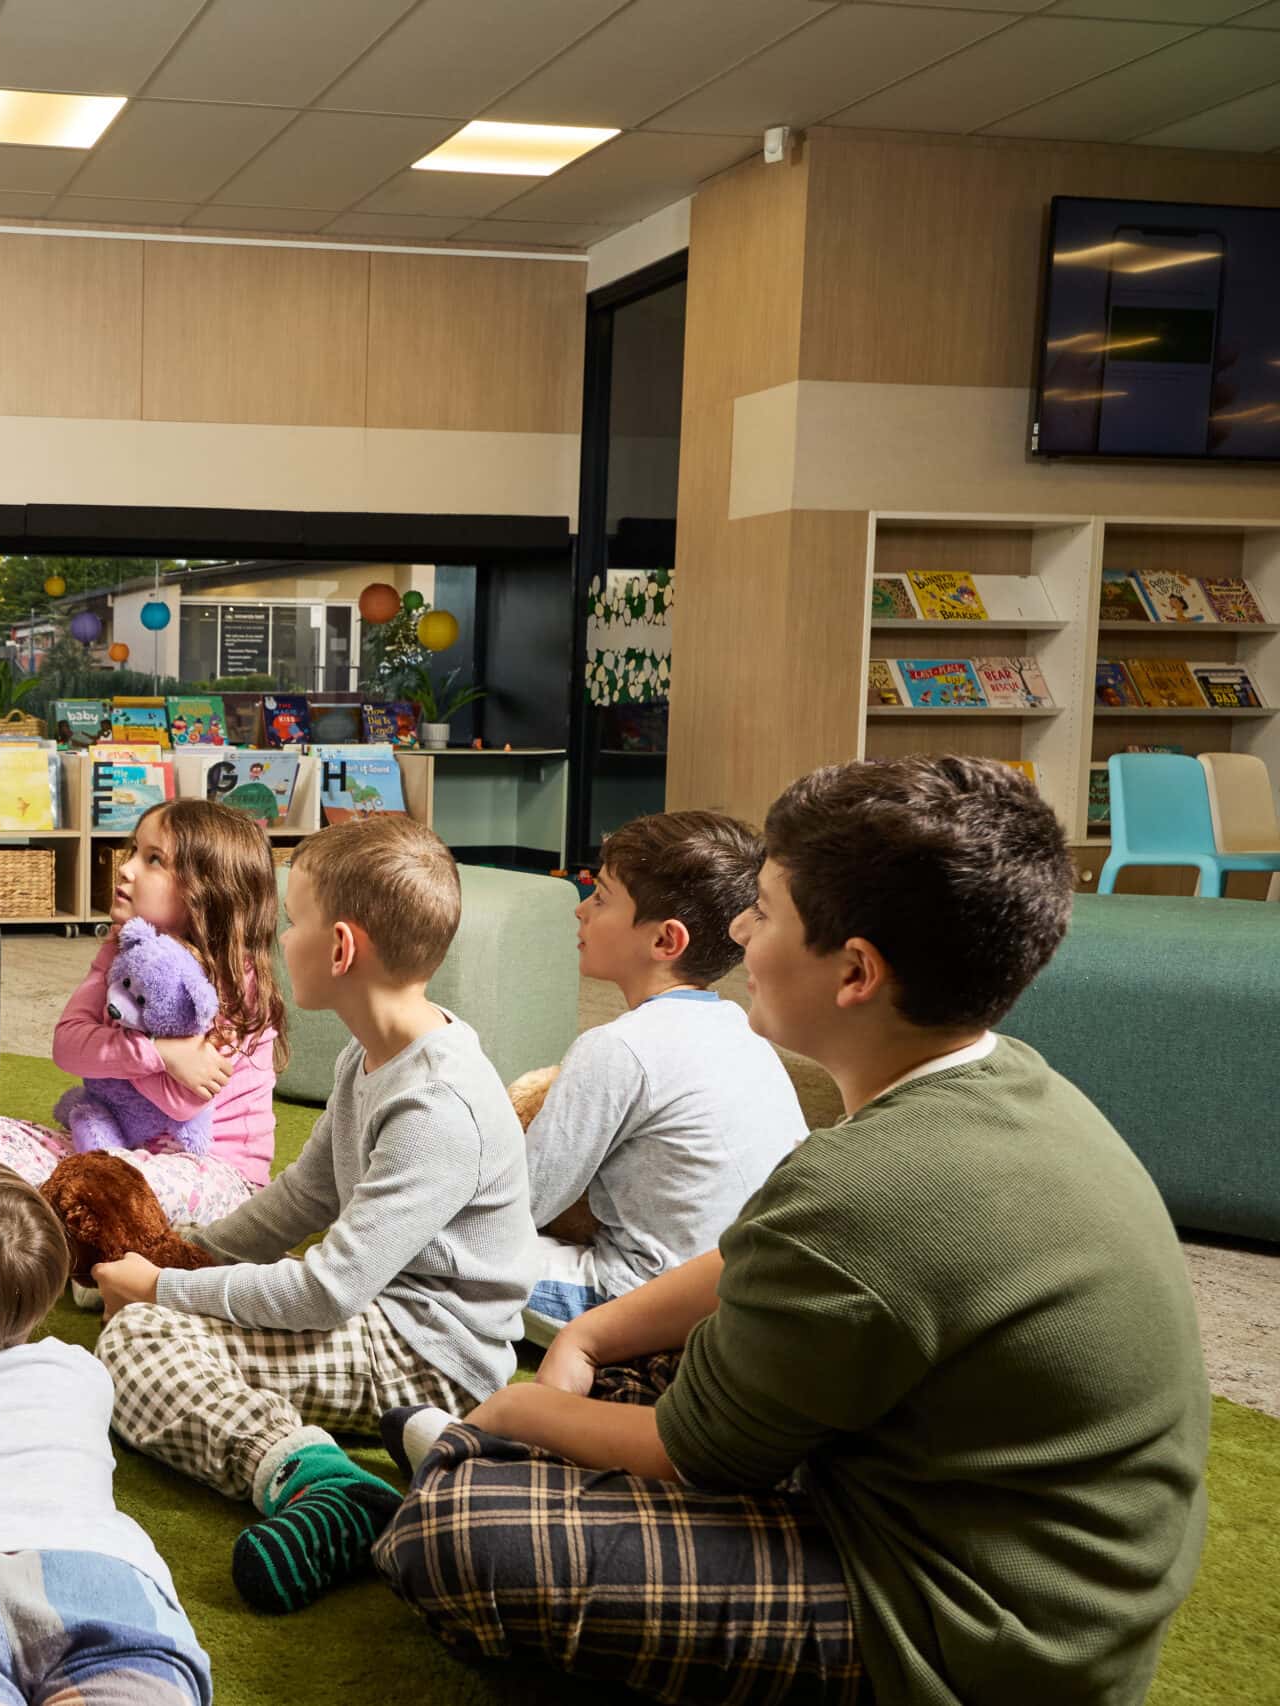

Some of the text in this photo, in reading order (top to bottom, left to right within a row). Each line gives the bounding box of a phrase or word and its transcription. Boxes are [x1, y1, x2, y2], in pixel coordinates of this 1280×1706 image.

[984, 667, 1012, 681] BEAR
[989, 682, 1020, 693] RESCUE
[1214, 693, 1238, 703] DAD
[66, 711, 99, 724] baby
[278, 715, 296, 723] KISS
[93, 761, 114, 792] E
[207, 761, 239, 793] G
[323, 760, 346, 792] H
[93, 795, 113, 827] F
